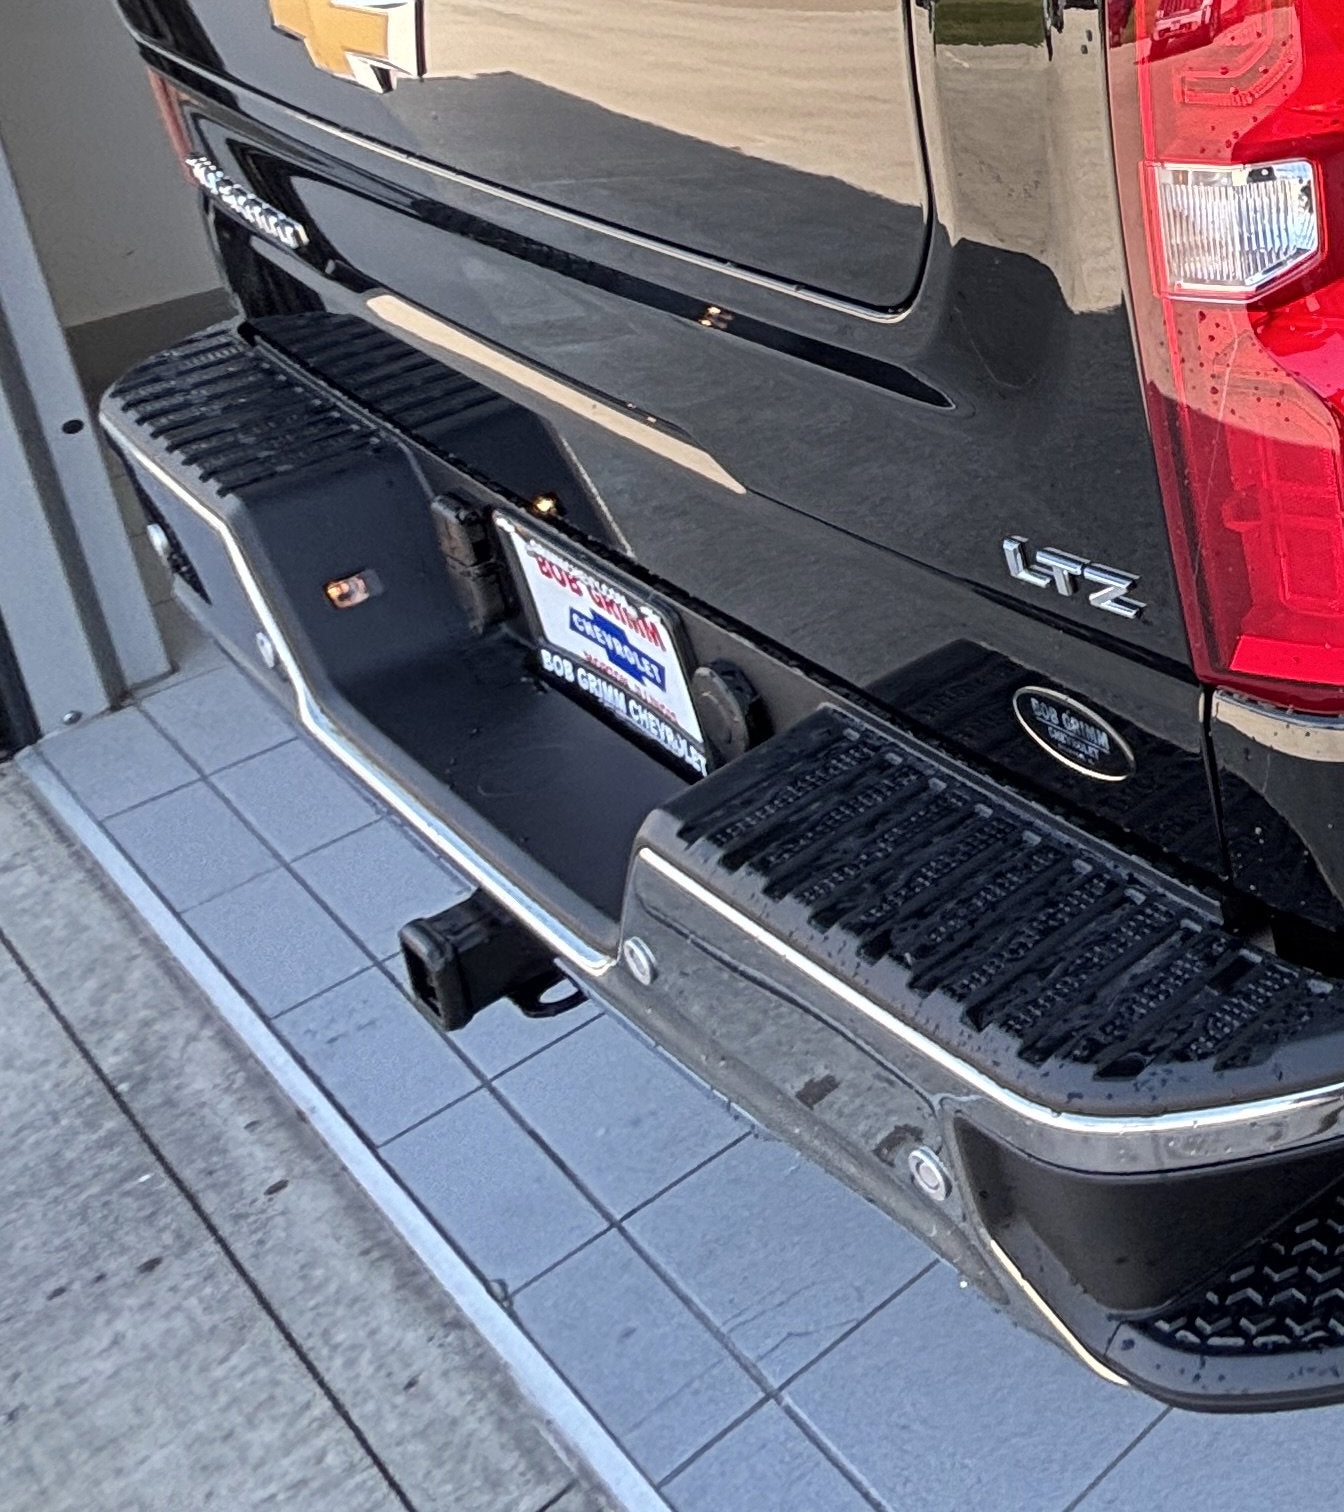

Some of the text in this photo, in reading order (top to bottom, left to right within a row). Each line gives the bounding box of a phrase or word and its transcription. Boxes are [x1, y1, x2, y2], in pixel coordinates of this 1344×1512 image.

[534, 552, 584, 598] BOB
[1002, 536, 1141, 619] LTZ
[572, 612, 664, 684] CHEVROLET
[540, 649, 575, 684] BOB
[576, 667, 627, 715] GRIMM
[628, 700, 708, 777] CHEVROLET
[1030, 696, 1111, 751] BOB GRIMM
